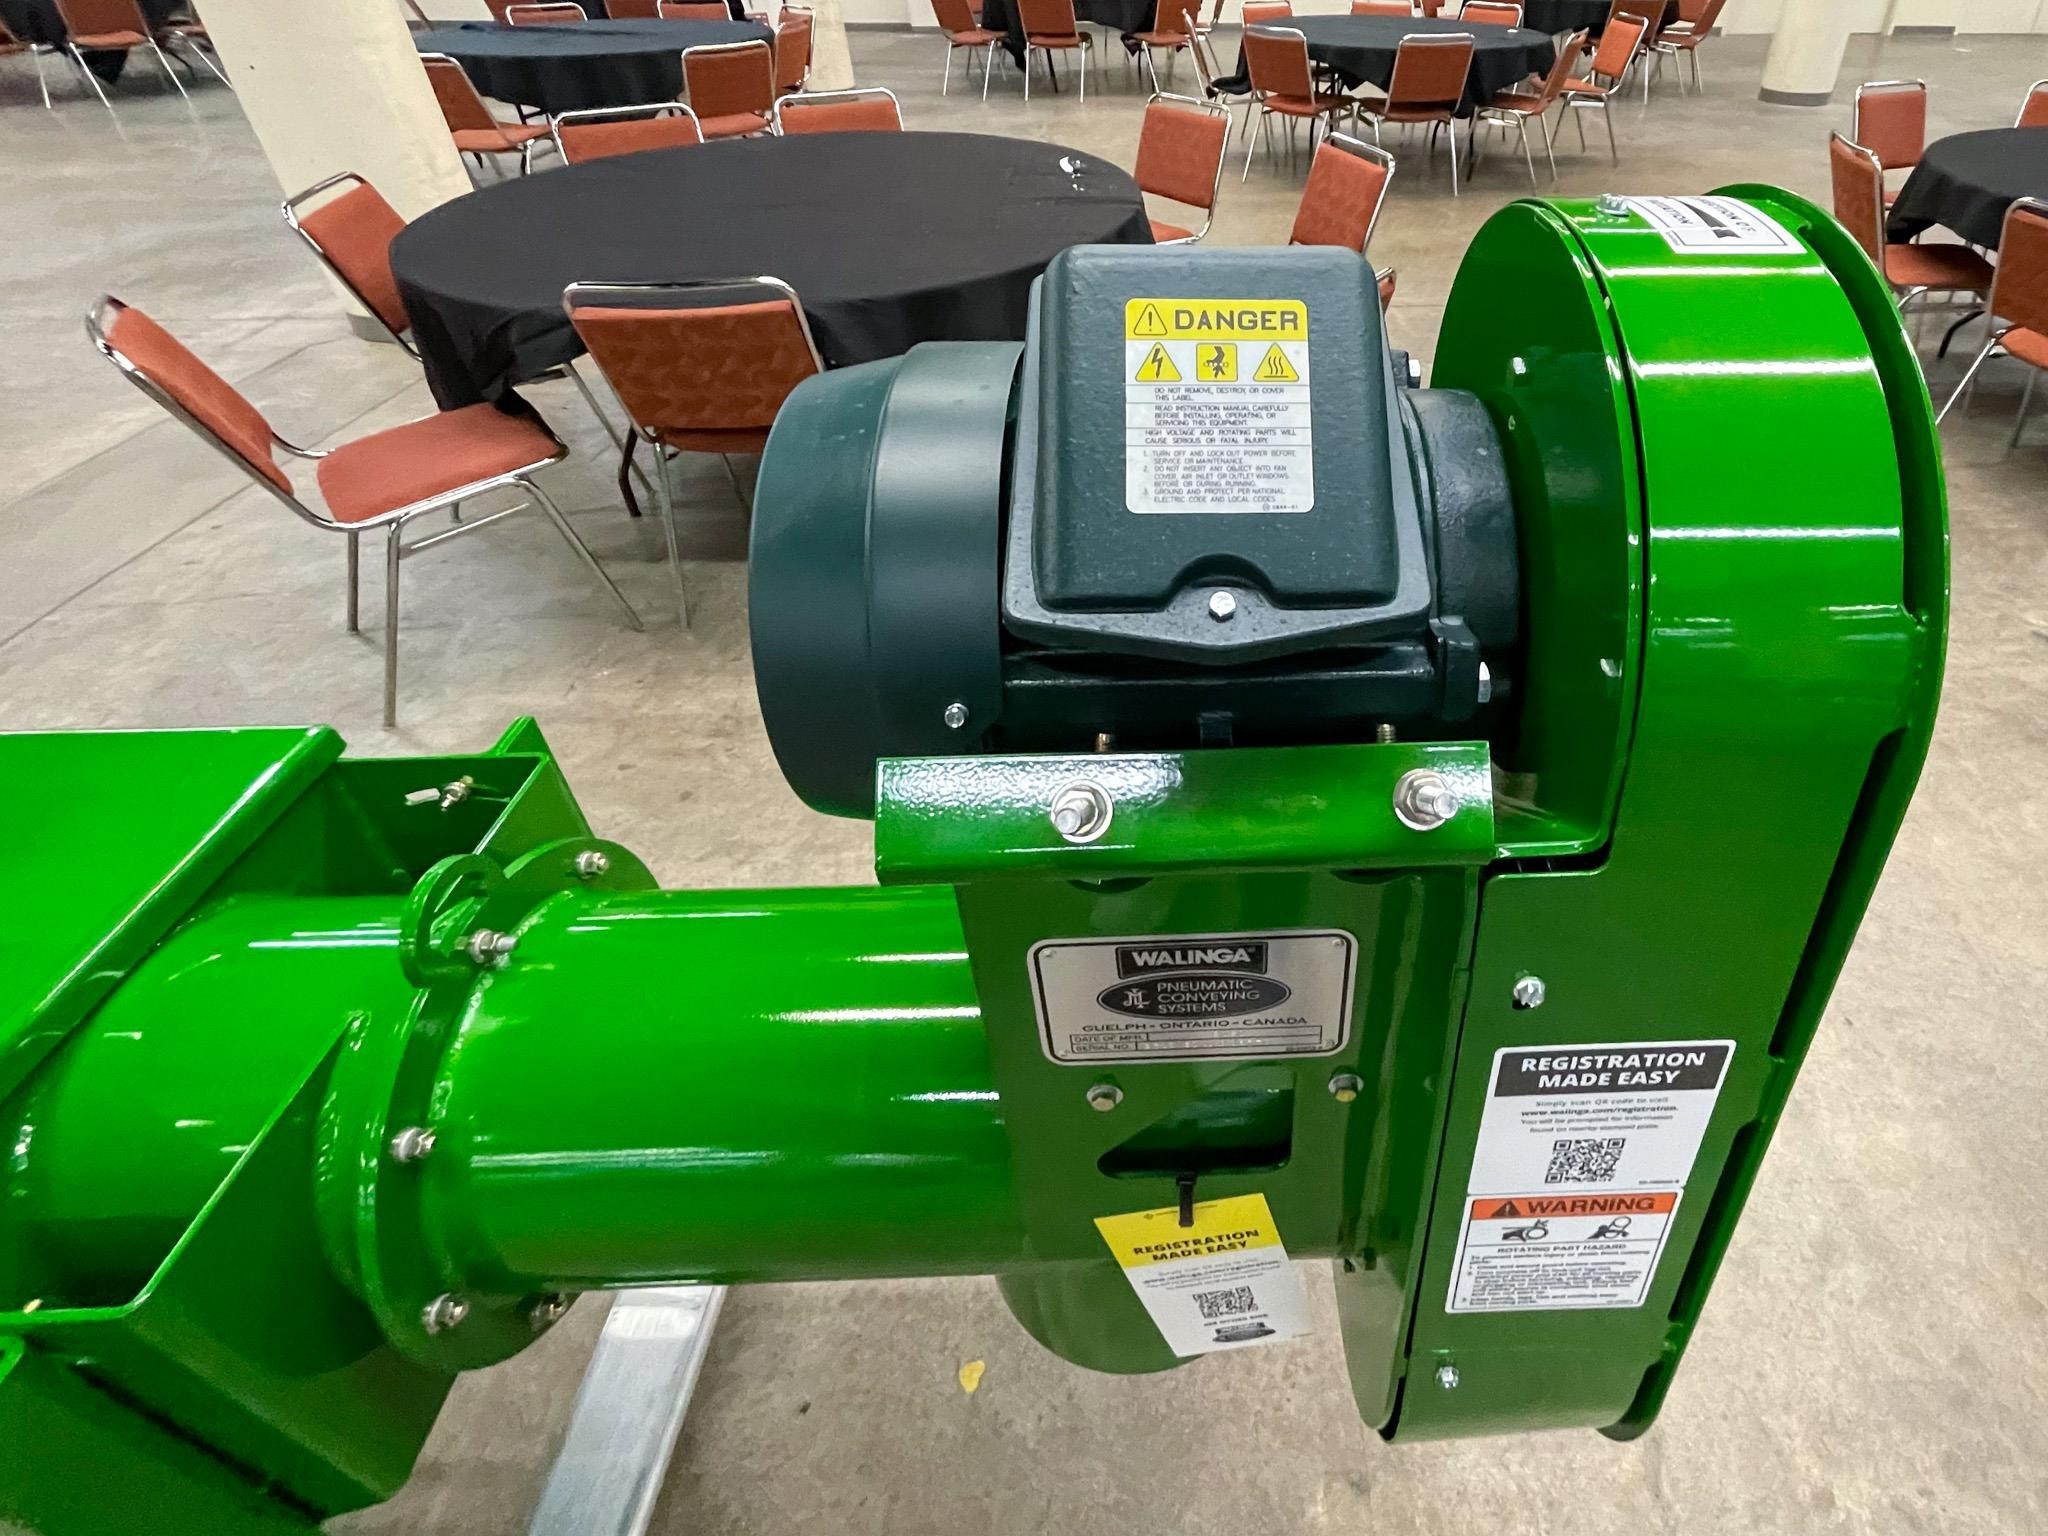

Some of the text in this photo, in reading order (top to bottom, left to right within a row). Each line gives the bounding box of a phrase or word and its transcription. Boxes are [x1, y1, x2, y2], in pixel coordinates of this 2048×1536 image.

[1175, 309, 1298, 331] DANGER
[1132, 947, 1252, 968] WALINGA
[1157, 979, 1254, 993] PNEUMATIC
[1157, 990, 1260, 1003] CONVEYING
[1158, 1002, 1227, 1014] SYSTEMS
[1082, 1023, 1146, 1032] GUELPH
[1160, 1020, 1230, 1030] ONTARIO
[1242, 1016, 1308, 1026] CANADA
[1075, 1044, 1109, 1052] SERIAL
[1521, 1052, 1706, 1073] REGISTRATION
[1538, 1070, 1681, 1089] MADE EASY
[1536, 1100, 1566, 1108] Simply
[1595, 1098, 1608, 1106] QR
[1611, 1097, 1634, 1105] code
[1528, 1197, 1655, 1213] WARNING
[1133, 1229, 1259, 1255] REGISTRATION
[1152, 1240, 1248, 1261] MADE EASY
